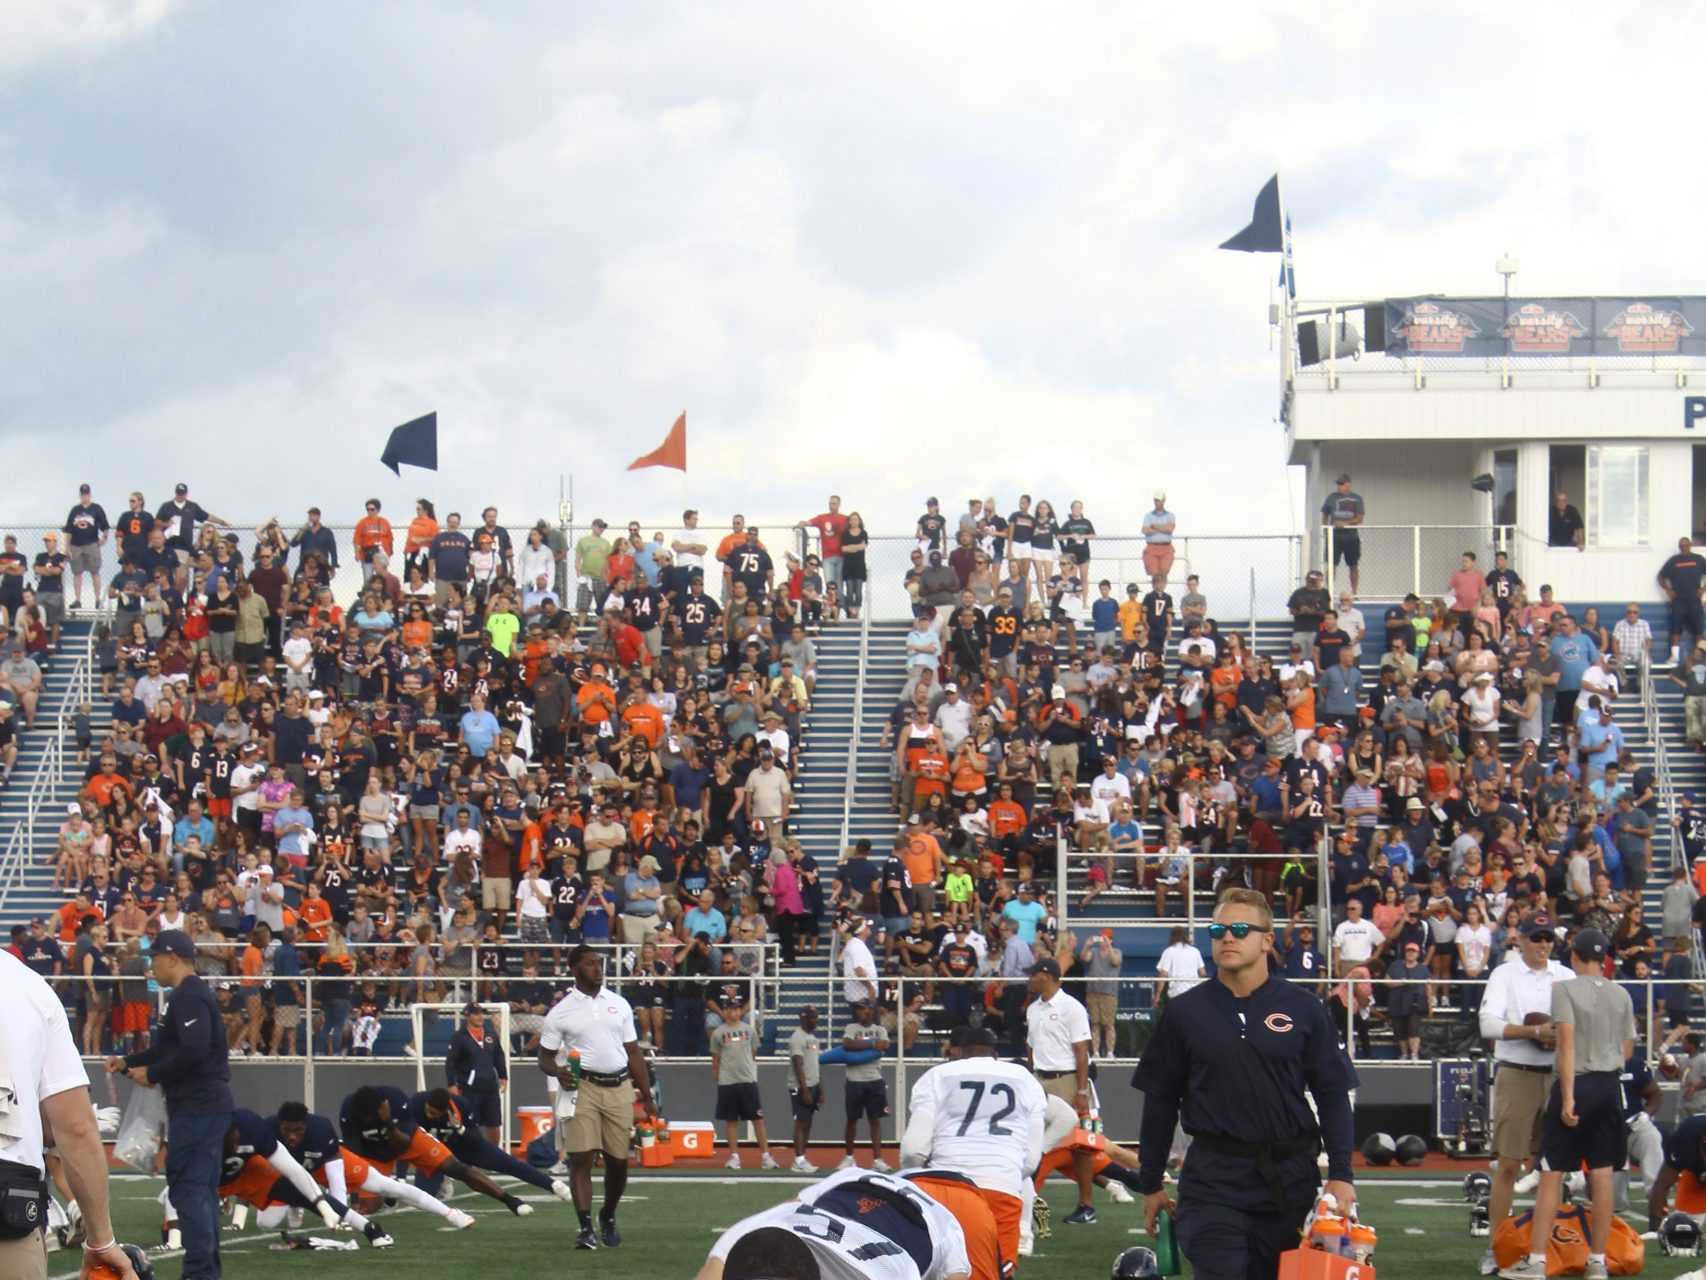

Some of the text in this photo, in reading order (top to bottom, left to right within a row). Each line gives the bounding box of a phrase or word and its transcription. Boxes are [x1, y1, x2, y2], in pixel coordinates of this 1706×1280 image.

[1684, 396, 1706, 428] P
[130, 520, 141, 534] 6
[740, 554, 759, 573] 75
[1497, 581, 1509, 597] 15
[632, 597, 650, 616] 34
[686, 604, 705, 623] 25
[1155, 599, 1166, 617] 17
[995, 616, 1016, 634] 33
[443, 669, 458, 688] 24
[192, 752, 200, 768] 6
[216, 761, 228, 778] 13
[326, 870, 341, 888] 75
[558, 886, 575, 903] 22
[483, 952, 498, 969] 23
[1302, 952, 1313, 969] 6
[1264, 1012, 1294, 1032] C
[957, 1081, 1016, 1137] 72
[683, 1132, 698, 1149] G
